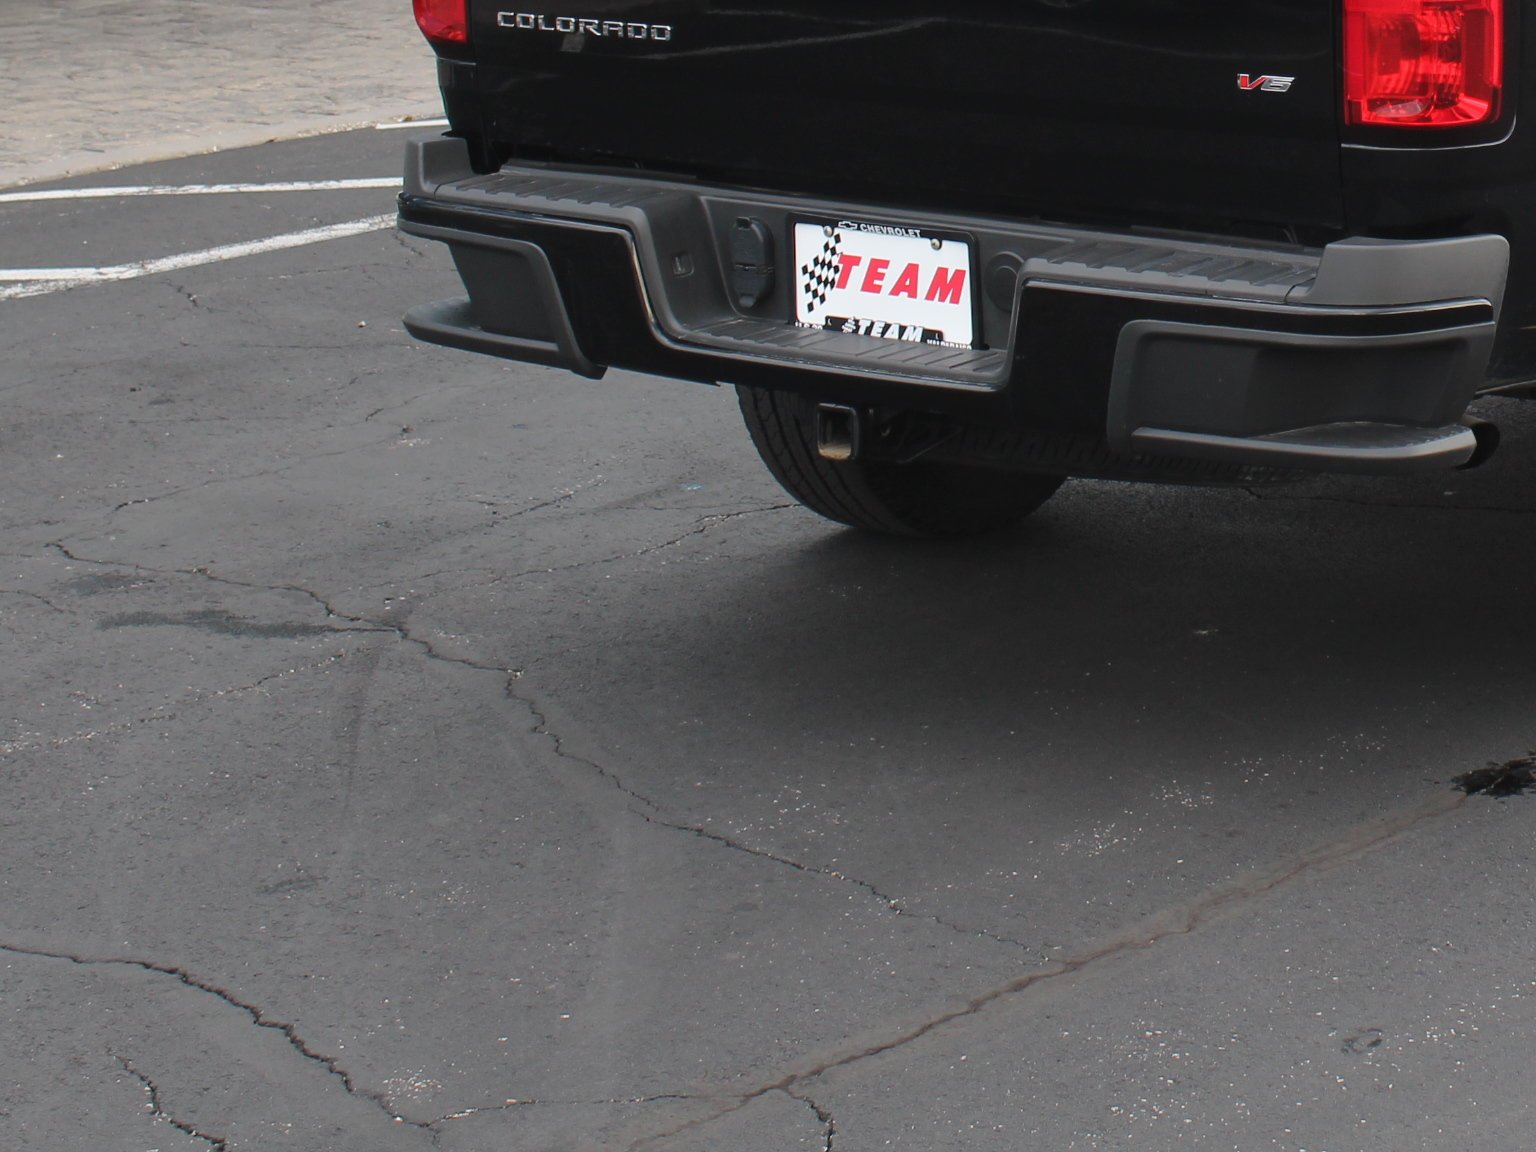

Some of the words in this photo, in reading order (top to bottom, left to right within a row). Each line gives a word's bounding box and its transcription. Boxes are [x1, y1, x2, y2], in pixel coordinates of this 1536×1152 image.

[497, 11, 672, 41] COLORADO
[1237, 74, 1295, 92] V6
[859, 223, 922, 239] CHEVROLET
[836, 254, 967, 305] TEAM
[857, 318, 926, 343] TEAM
